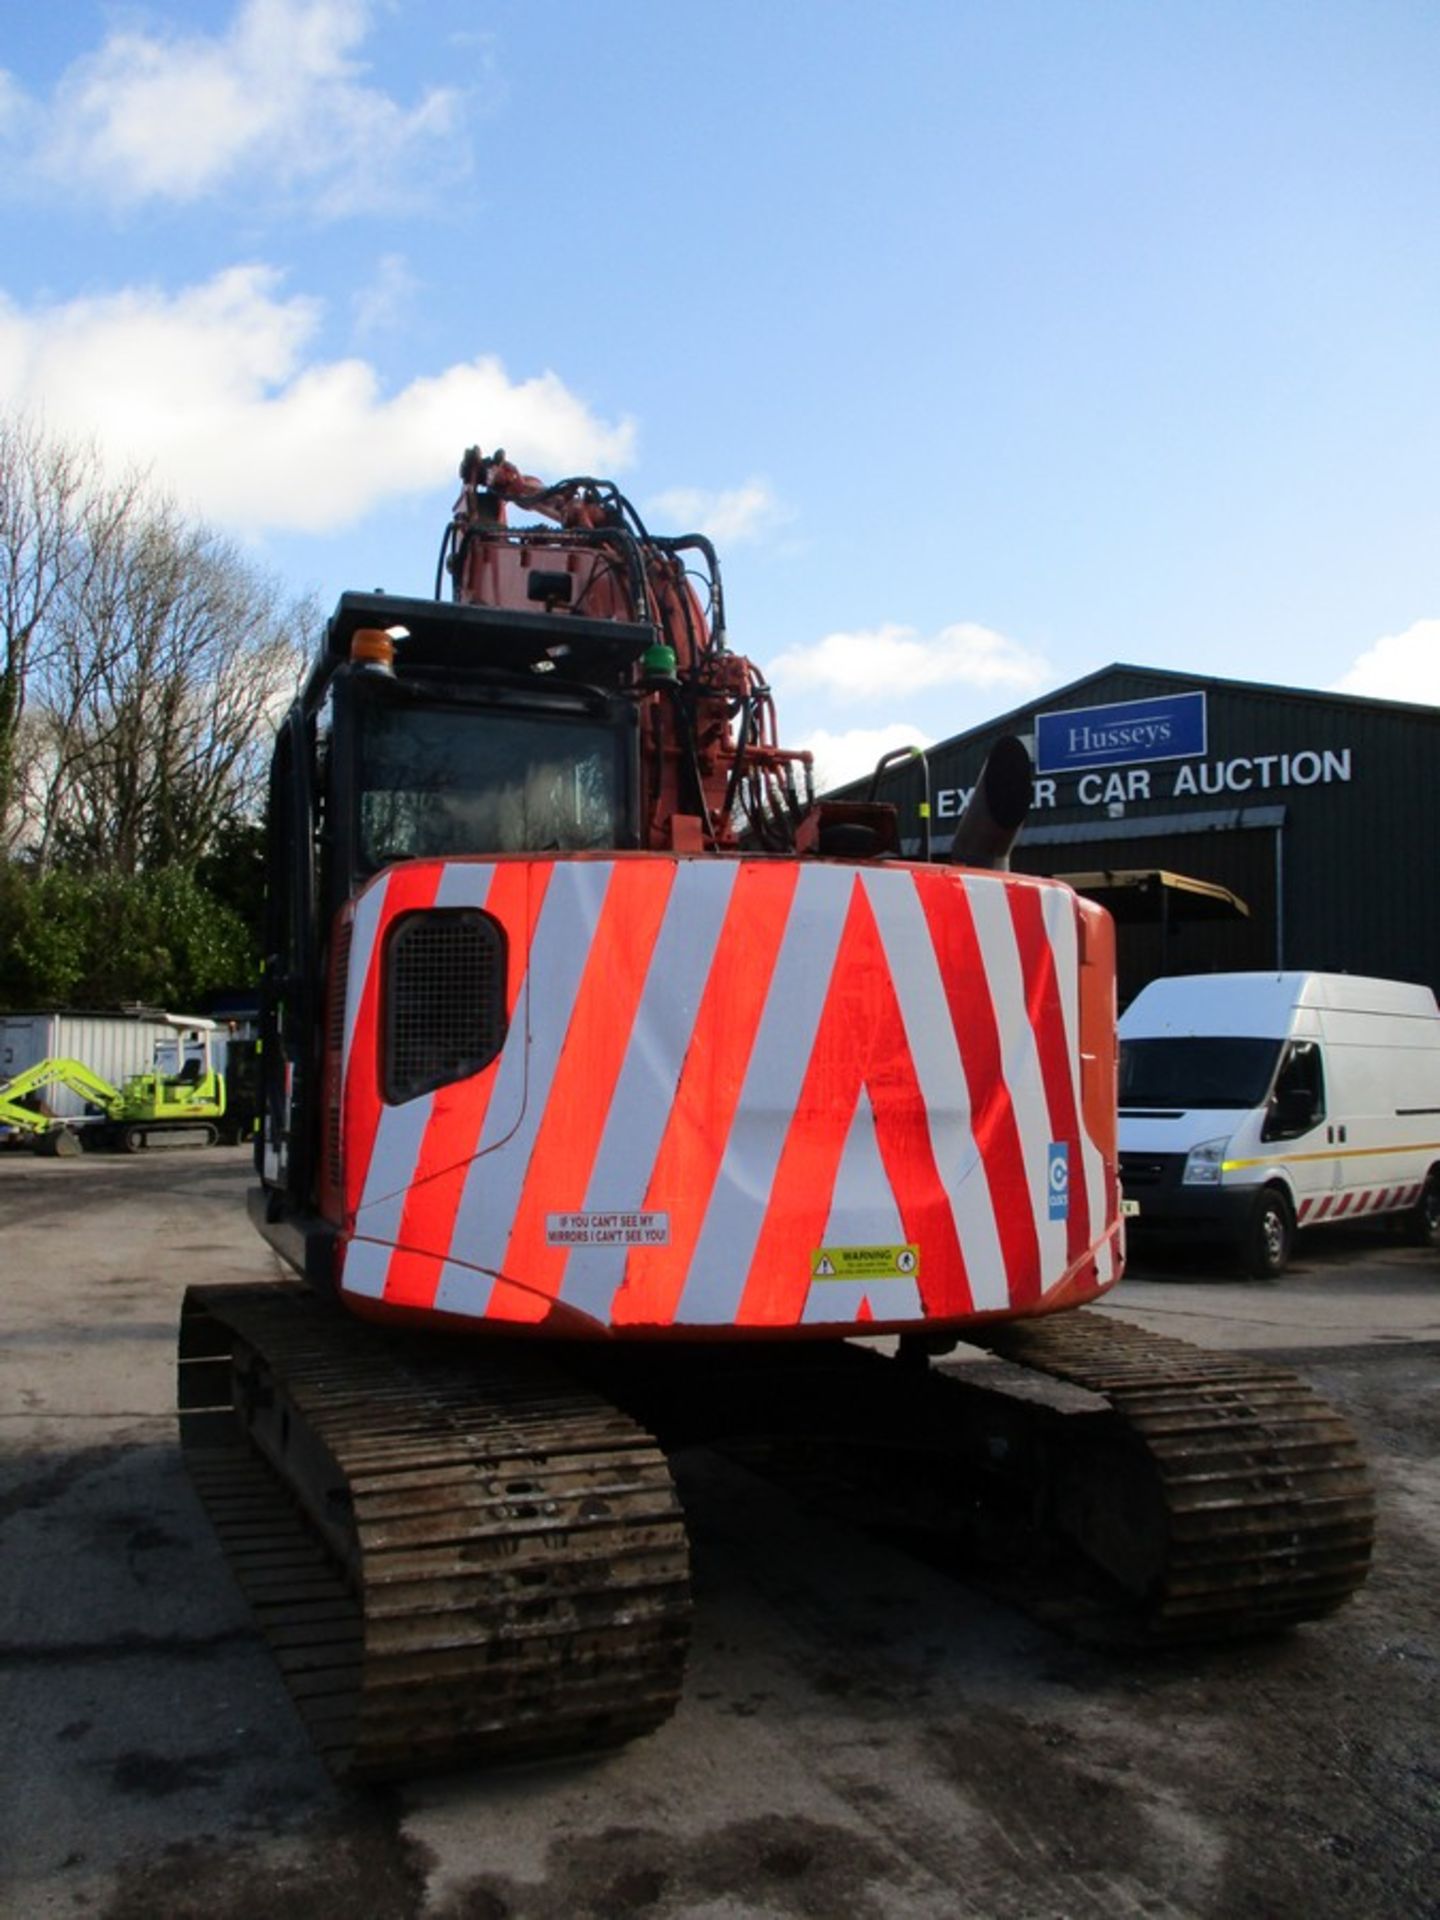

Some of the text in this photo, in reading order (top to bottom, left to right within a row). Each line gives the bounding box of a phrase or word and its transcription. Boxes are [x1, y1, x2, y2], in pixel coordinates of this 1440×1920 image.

[1068, 720, 1171, 753] Husseys
[937, 748, 1352, 818] EXR CAR AUCTION
[571, 1216, 589, 1227] YOU
[591, 1216, 617, 1227] CAN'T
[620, 1216, 638, 1227] SEE
[640, 1216, 654, 1226] MY
[548, 1231, 588, 1242] MIRRORS
[596, 1231, 622, 1242] CAN'T
[625, 1231, 642, 1242] SEE
[843, 1249, 893, 1261] WARNING
